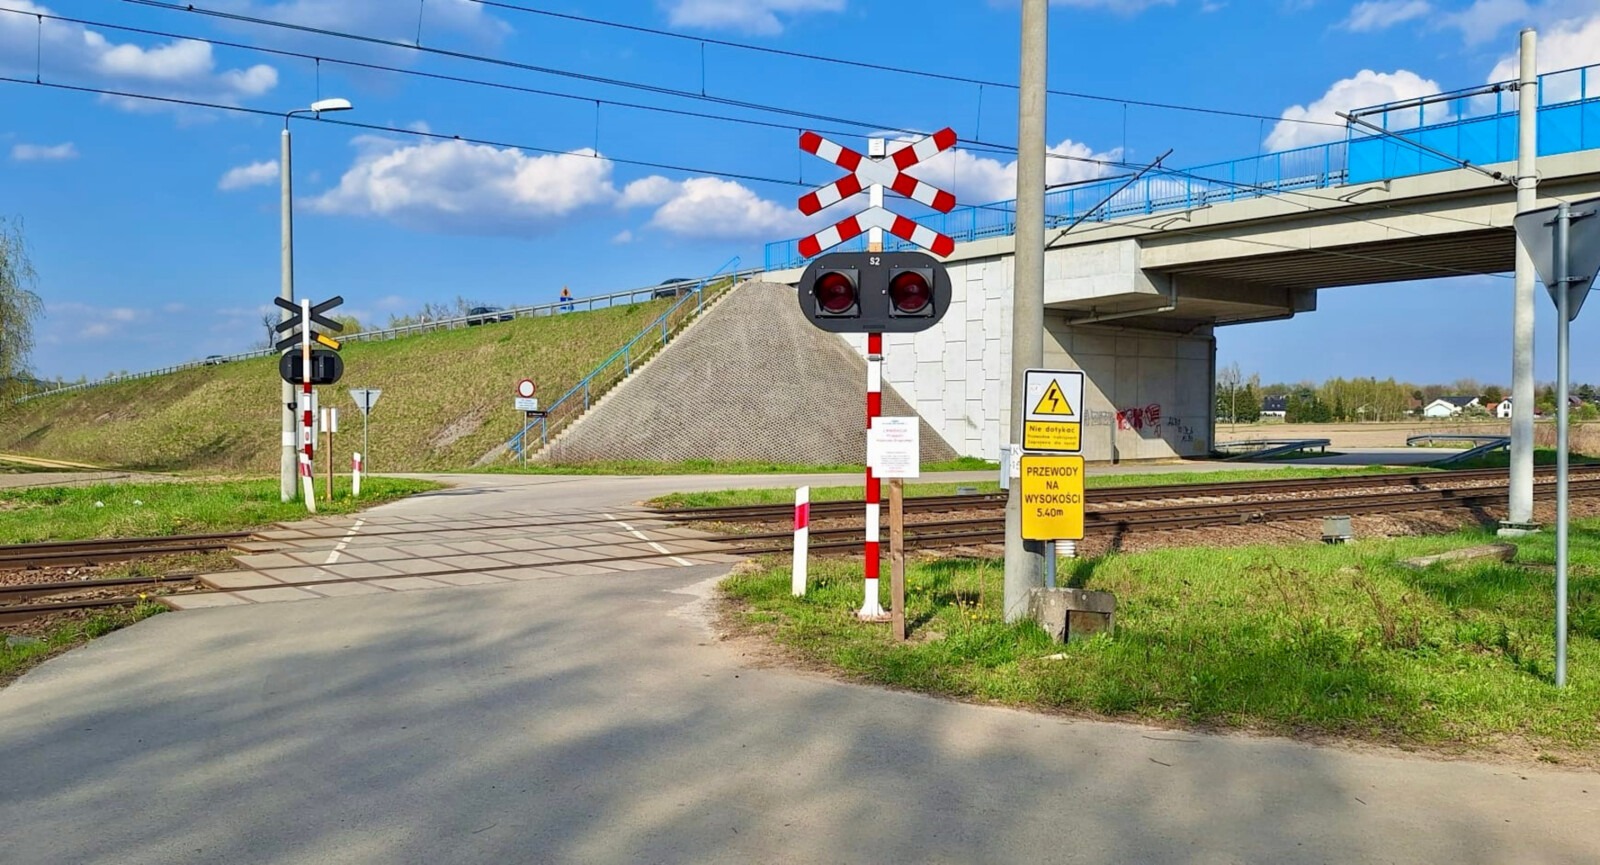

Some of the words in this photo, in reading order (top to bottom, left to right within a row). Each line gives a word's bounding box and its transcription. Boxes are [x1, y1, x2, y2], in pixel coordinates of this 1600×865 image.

[869, 257, 880, 266] S2
[1026, 467, 1079, 477] PRZEWODY
[1046, 480, 1059, 490] NA
[1024, 492, 1081, 504] WYSOKOŚCI
[1036, 508, 1064, 518] 5.40m
